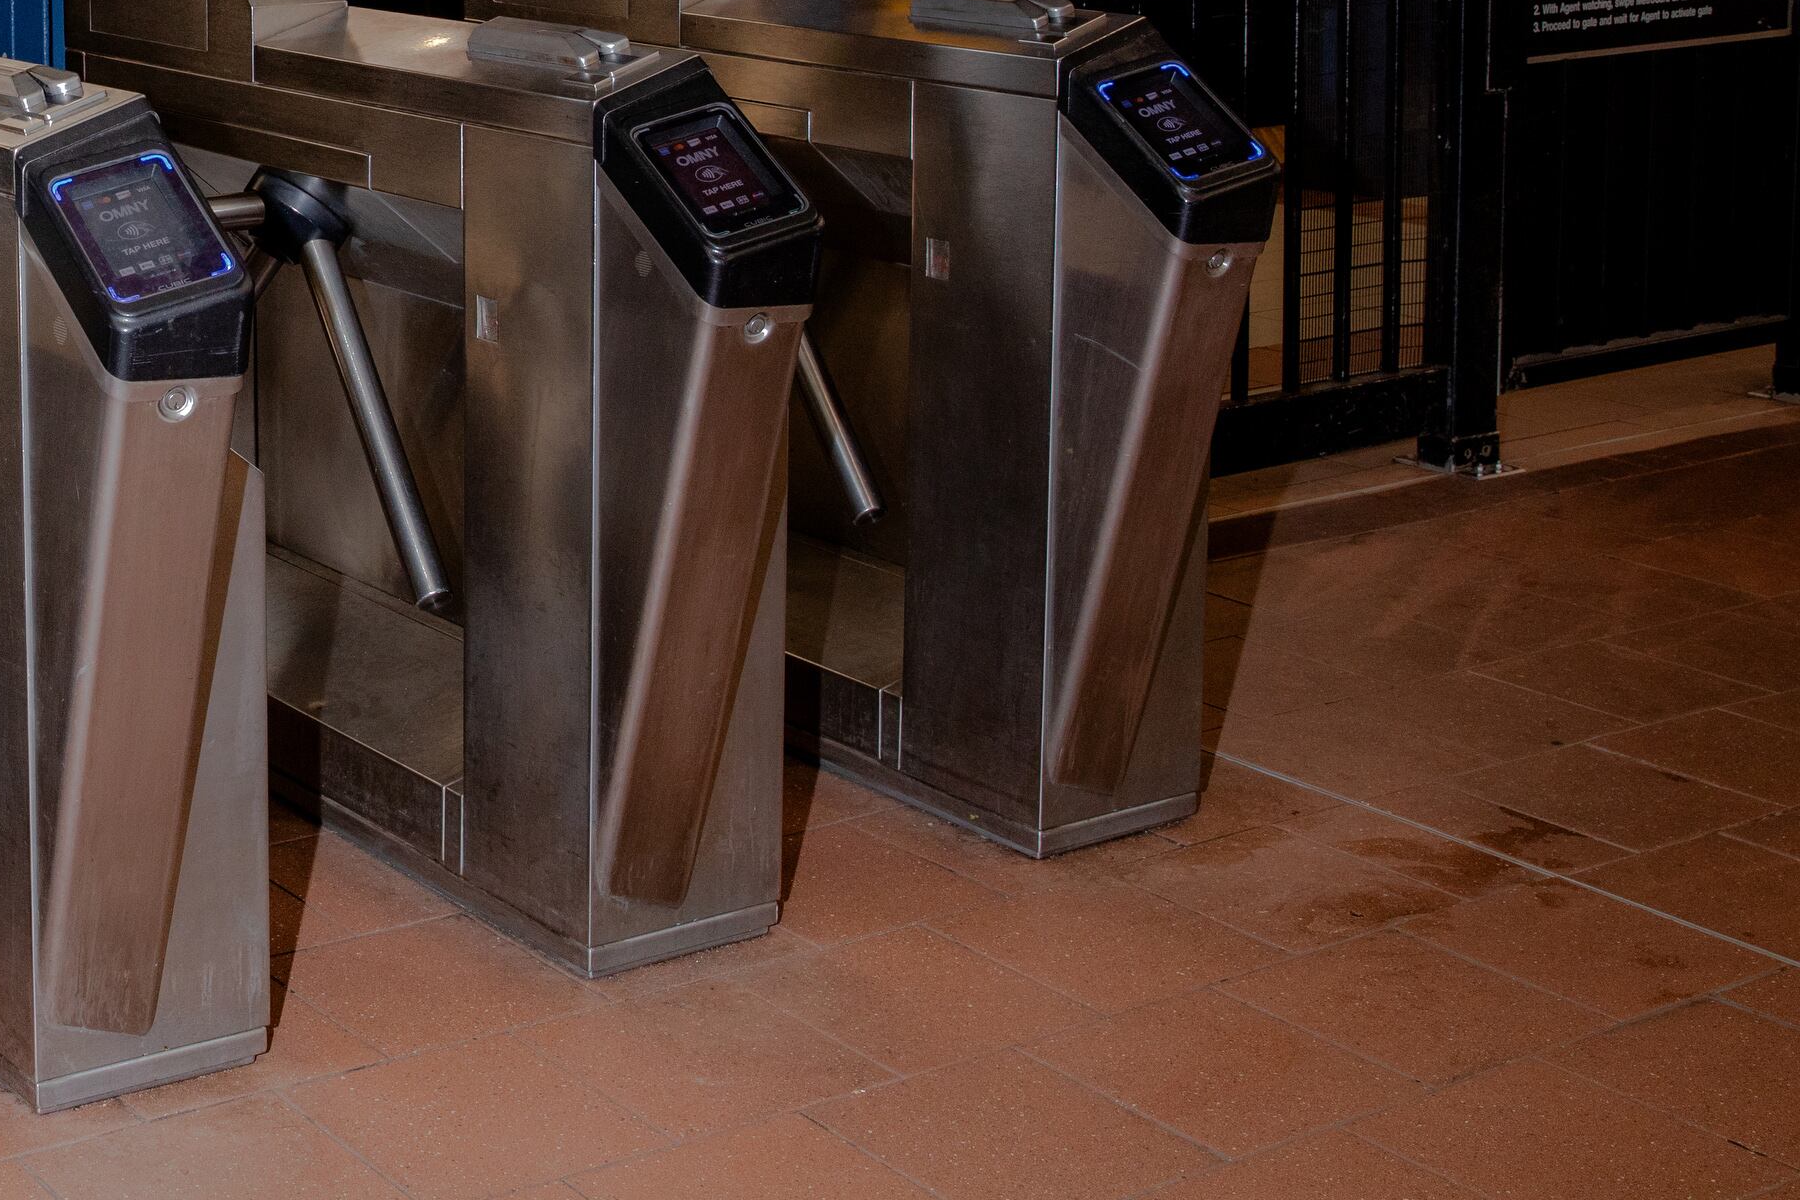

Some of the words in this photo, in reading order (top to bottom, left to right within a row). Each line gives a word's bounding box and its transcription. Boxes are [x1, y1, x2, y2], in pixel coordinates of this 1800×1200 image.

[1542, 3, 1559, 15] With
[1559, 1, 1580, 15] Agent
[1542, 18, 1571, 32] Proceed
[1572, 19, 1581, 29] to
[1582, 17, 1597, 29] gate
[1599, 15, 1613, 27] and
[1613, 12, 1628, 25] wait
[1629, 11, 1639, 23] for
[1640, 9, 1661, 24] Agent
[1662, 9, 1670, 19] to
[1670, 6, 1696, 19] activate
[1697, 4, 1713, 19] gate
[1138, 99, 1177, 118] OMNY
[1165, 136, 1181, 145] TAP
[1182, 128, 1203, 141] HERE
[676, 146, 720, 167] OMNY
[702, 186, 719, 197] TAP
[720, 179, 745, 192] HERE
[99, 198, 150, 223] OMNY
[121, 245, 141, 257] TAP
[142, 236, 170, 250] HERE
[157, 277, 193, 291] CUBIC
